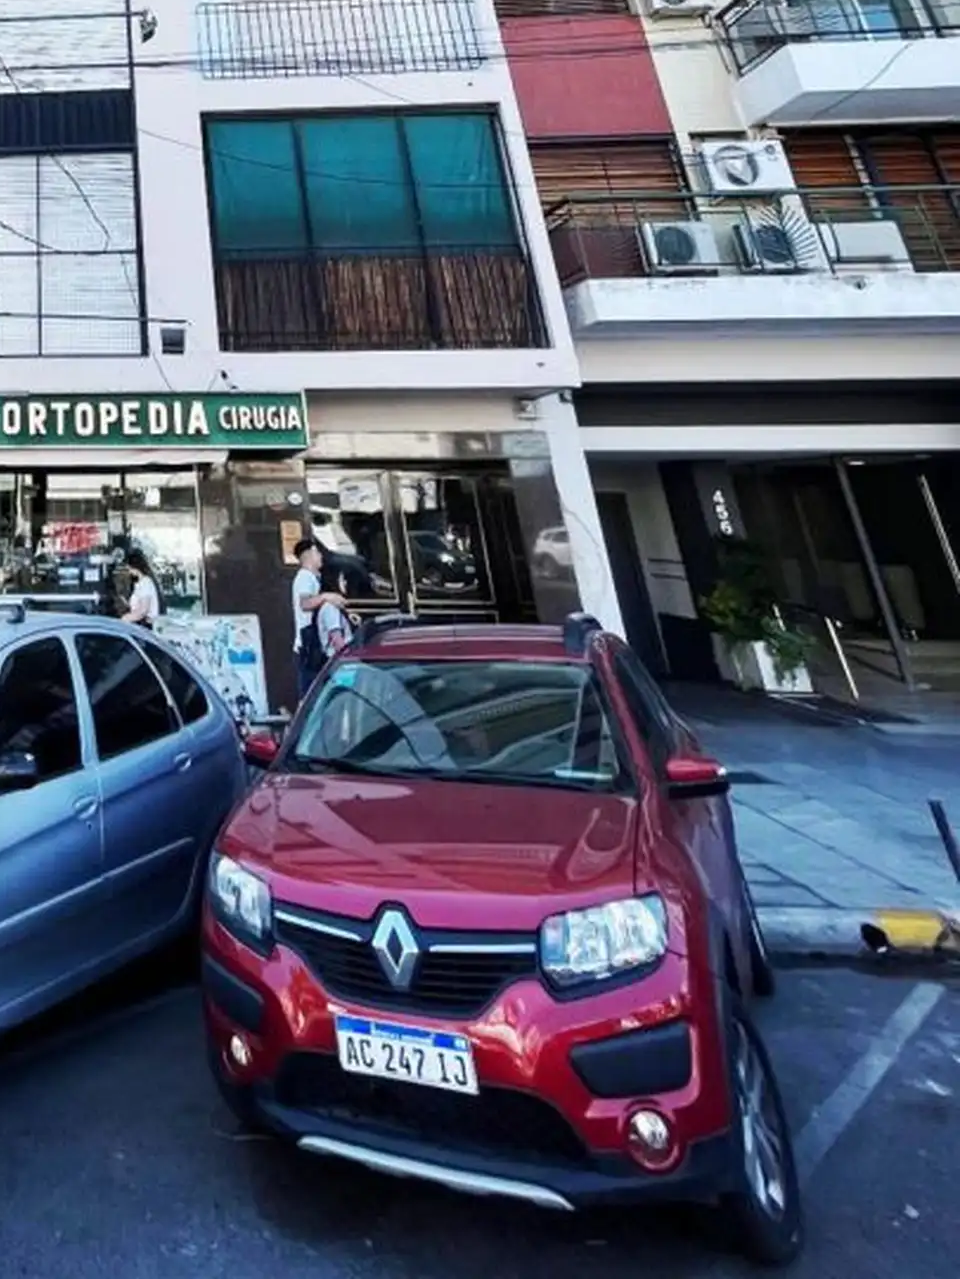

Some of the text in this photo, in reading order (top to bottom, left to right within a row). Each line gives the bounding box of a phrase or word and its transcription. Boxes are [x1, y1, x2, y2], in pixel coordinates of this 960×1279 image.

[2, 401, 210, 436] ORTOPEDIA
[218, 405, 303, 430] CIRUGIA
[346, 1036, 375, 1068] AC
[381, 1043, 425, 1080] 247
